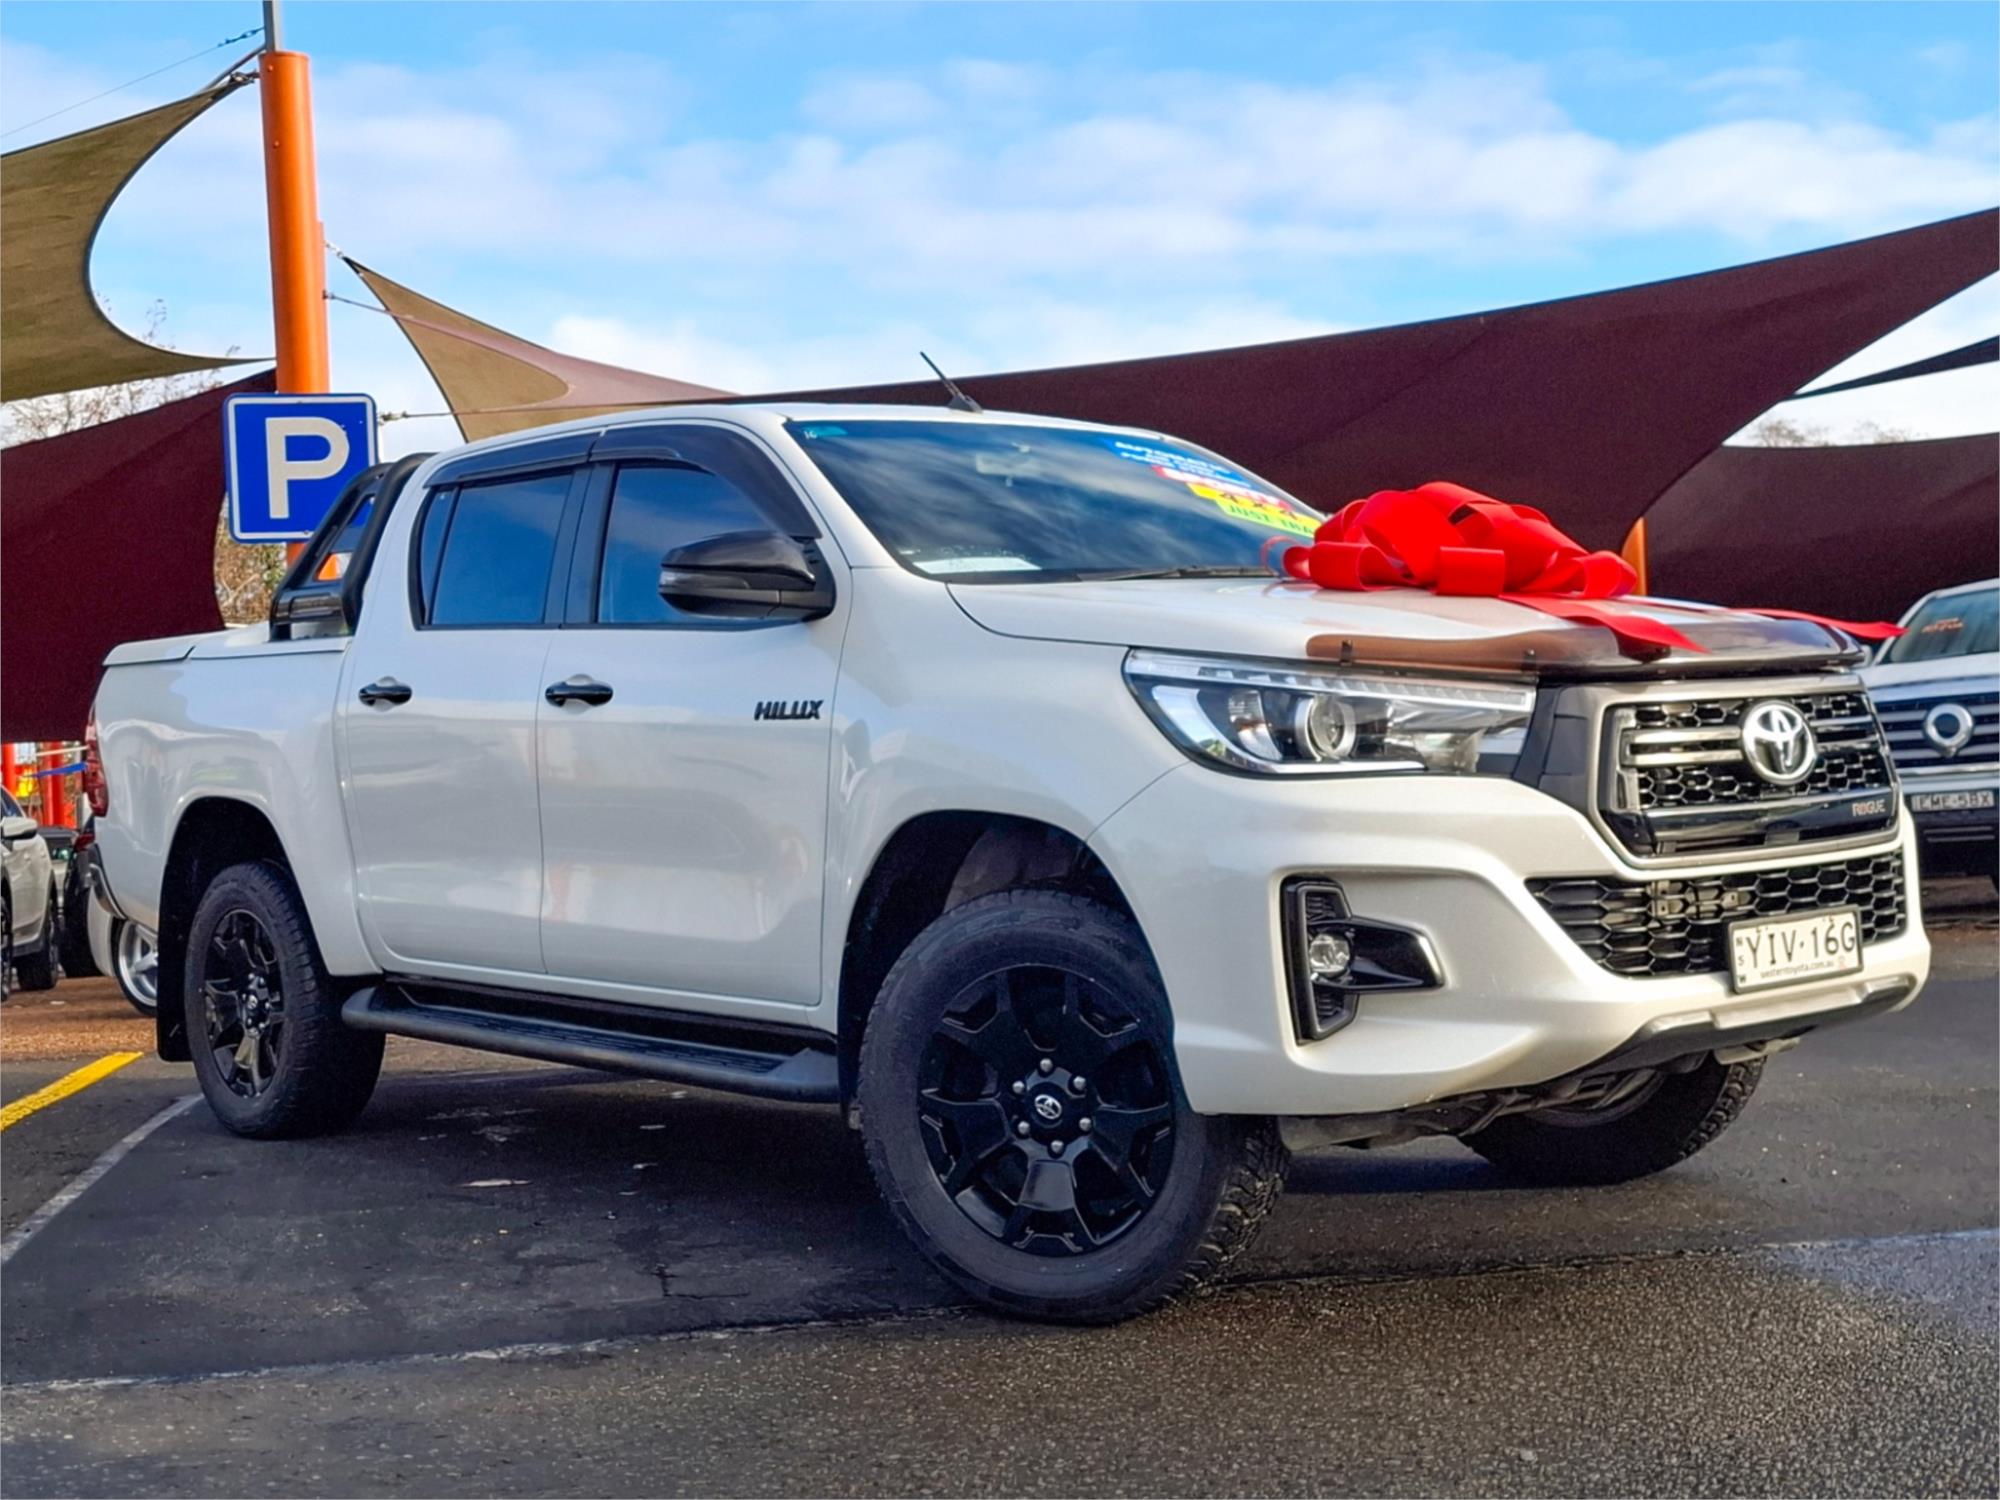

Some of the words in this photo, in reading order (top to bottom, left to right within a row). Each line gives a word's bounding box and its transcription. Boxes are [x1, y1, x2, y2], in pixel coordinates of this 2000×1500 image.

[265, 416, 350, 519] P
[754, 700, 824, 720] HILUX
[1852, 799, 1886, 816] ROGUE
